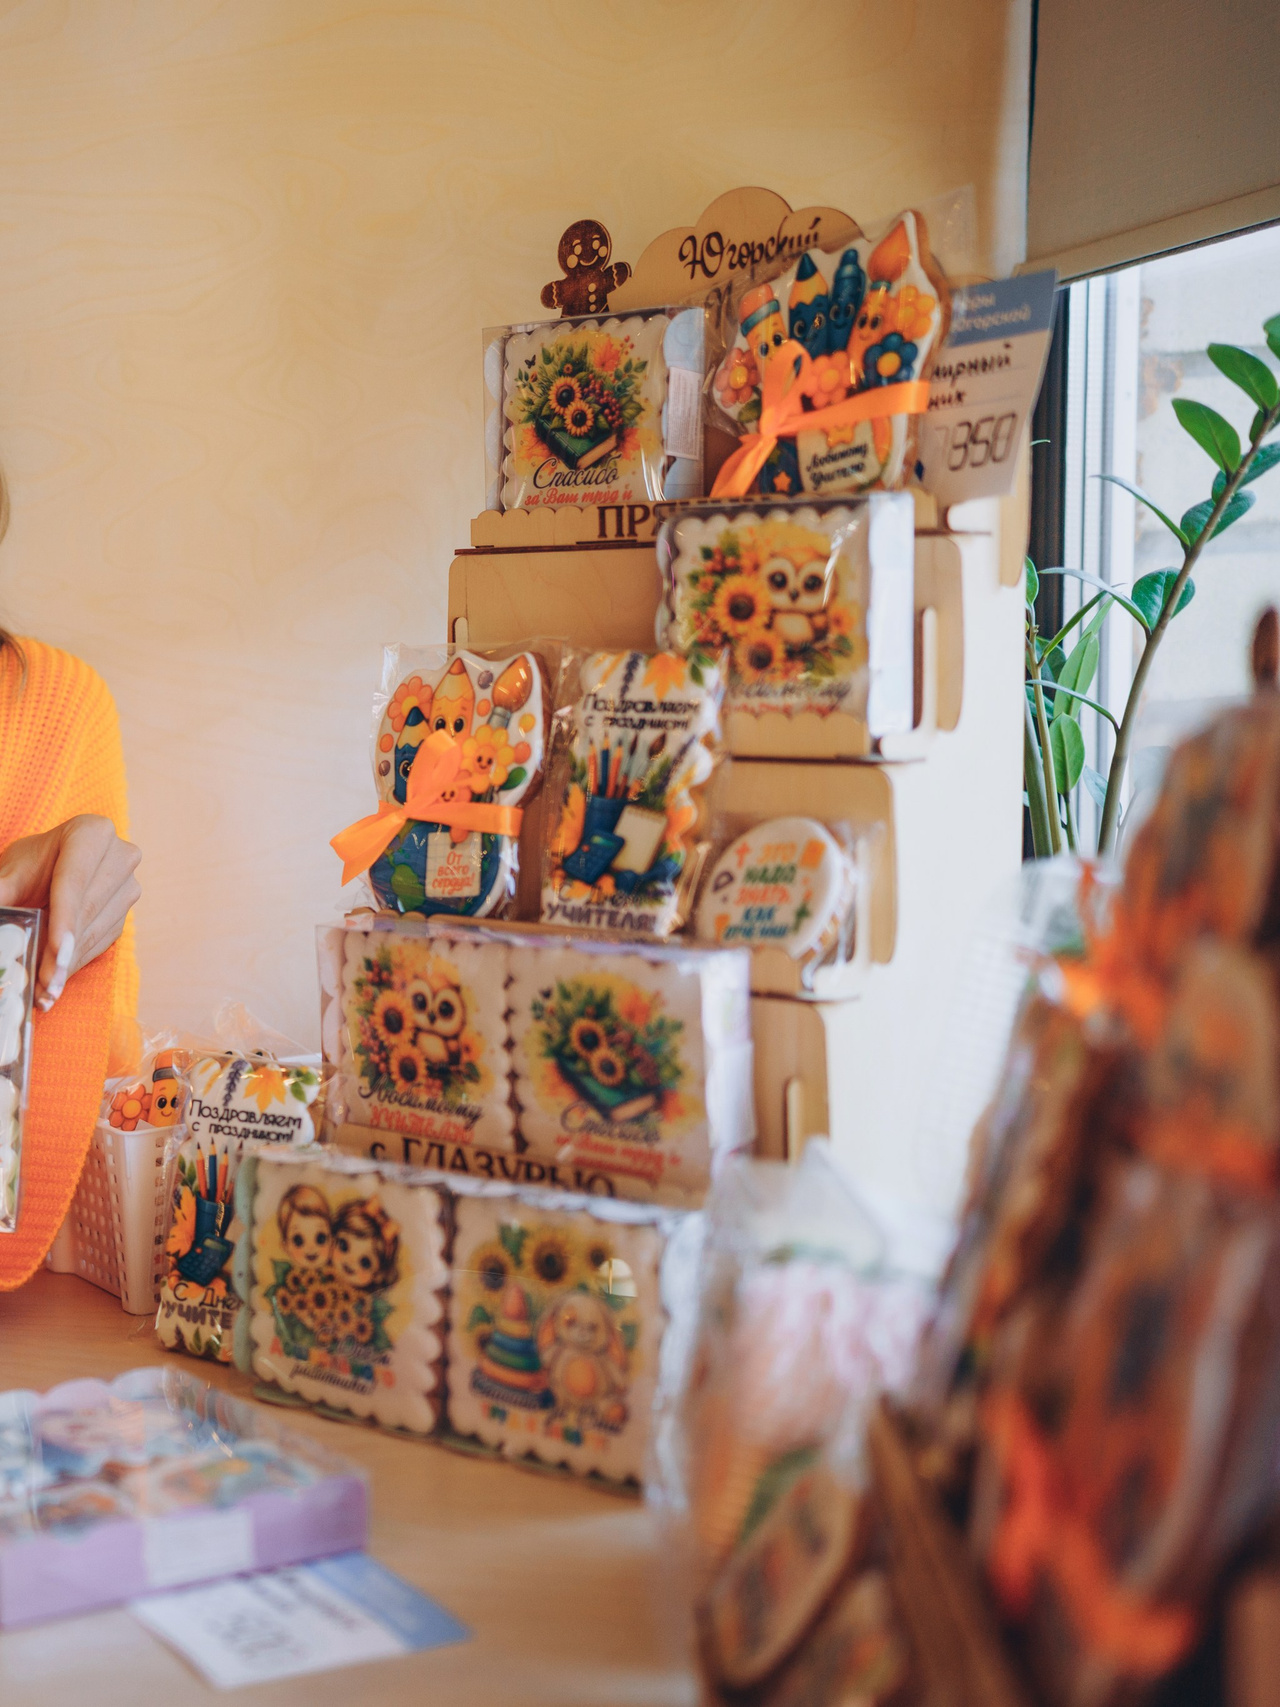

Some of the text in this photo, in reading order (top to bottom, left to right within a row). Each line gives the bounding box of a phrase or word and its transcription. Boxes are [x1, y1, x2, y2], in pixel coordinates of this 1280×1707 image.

[678, 215, 821, 281] Югорский
[949, 411, 1017, 470] 350
[533, 454, 623, 489] Спасибо
[524, 492, 540, 506] за
[542, 487, 579, 505] Ваш
[581, 489, 619, 505] труд
[437, 864, 470, 876] всего
[446, 850, 463, 865] От
[431, 872, 476, 895] сердца!
[188, 1099, 302, 1130] Поздравляем
[191, 1121, 294, 1142] с праздником!
[401, 1136, 616, 1199] ГЛАЗУРЬЮ
[173, 1282, 189, 1302] С
[164, 1300, 233, 1330] УЧИТЕ
